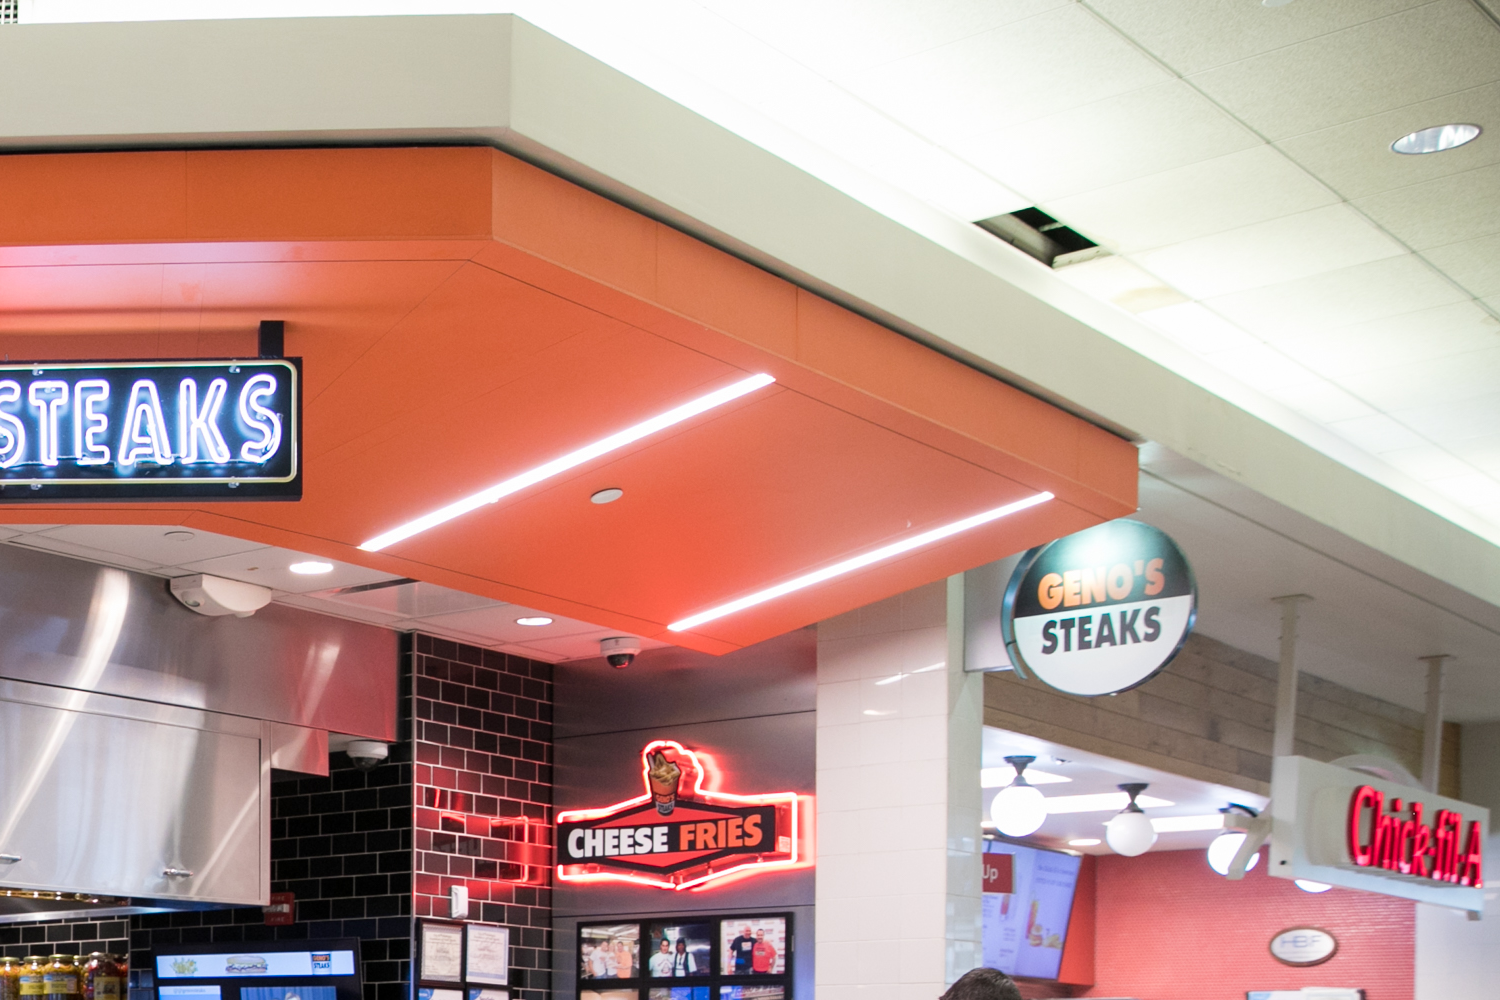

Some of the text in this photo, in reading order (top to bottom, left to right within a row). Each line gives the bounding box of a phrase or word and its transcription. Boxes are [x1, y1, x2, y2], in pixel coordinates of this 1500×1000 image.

[1037, 558, 1166, 610] GENO'S
[1040, 606, 1163, 655] STEAKS
[567, 814, 763, 858] CHEESE FRIES
[1348, 785, 1483, 889] Chick-fil-A
